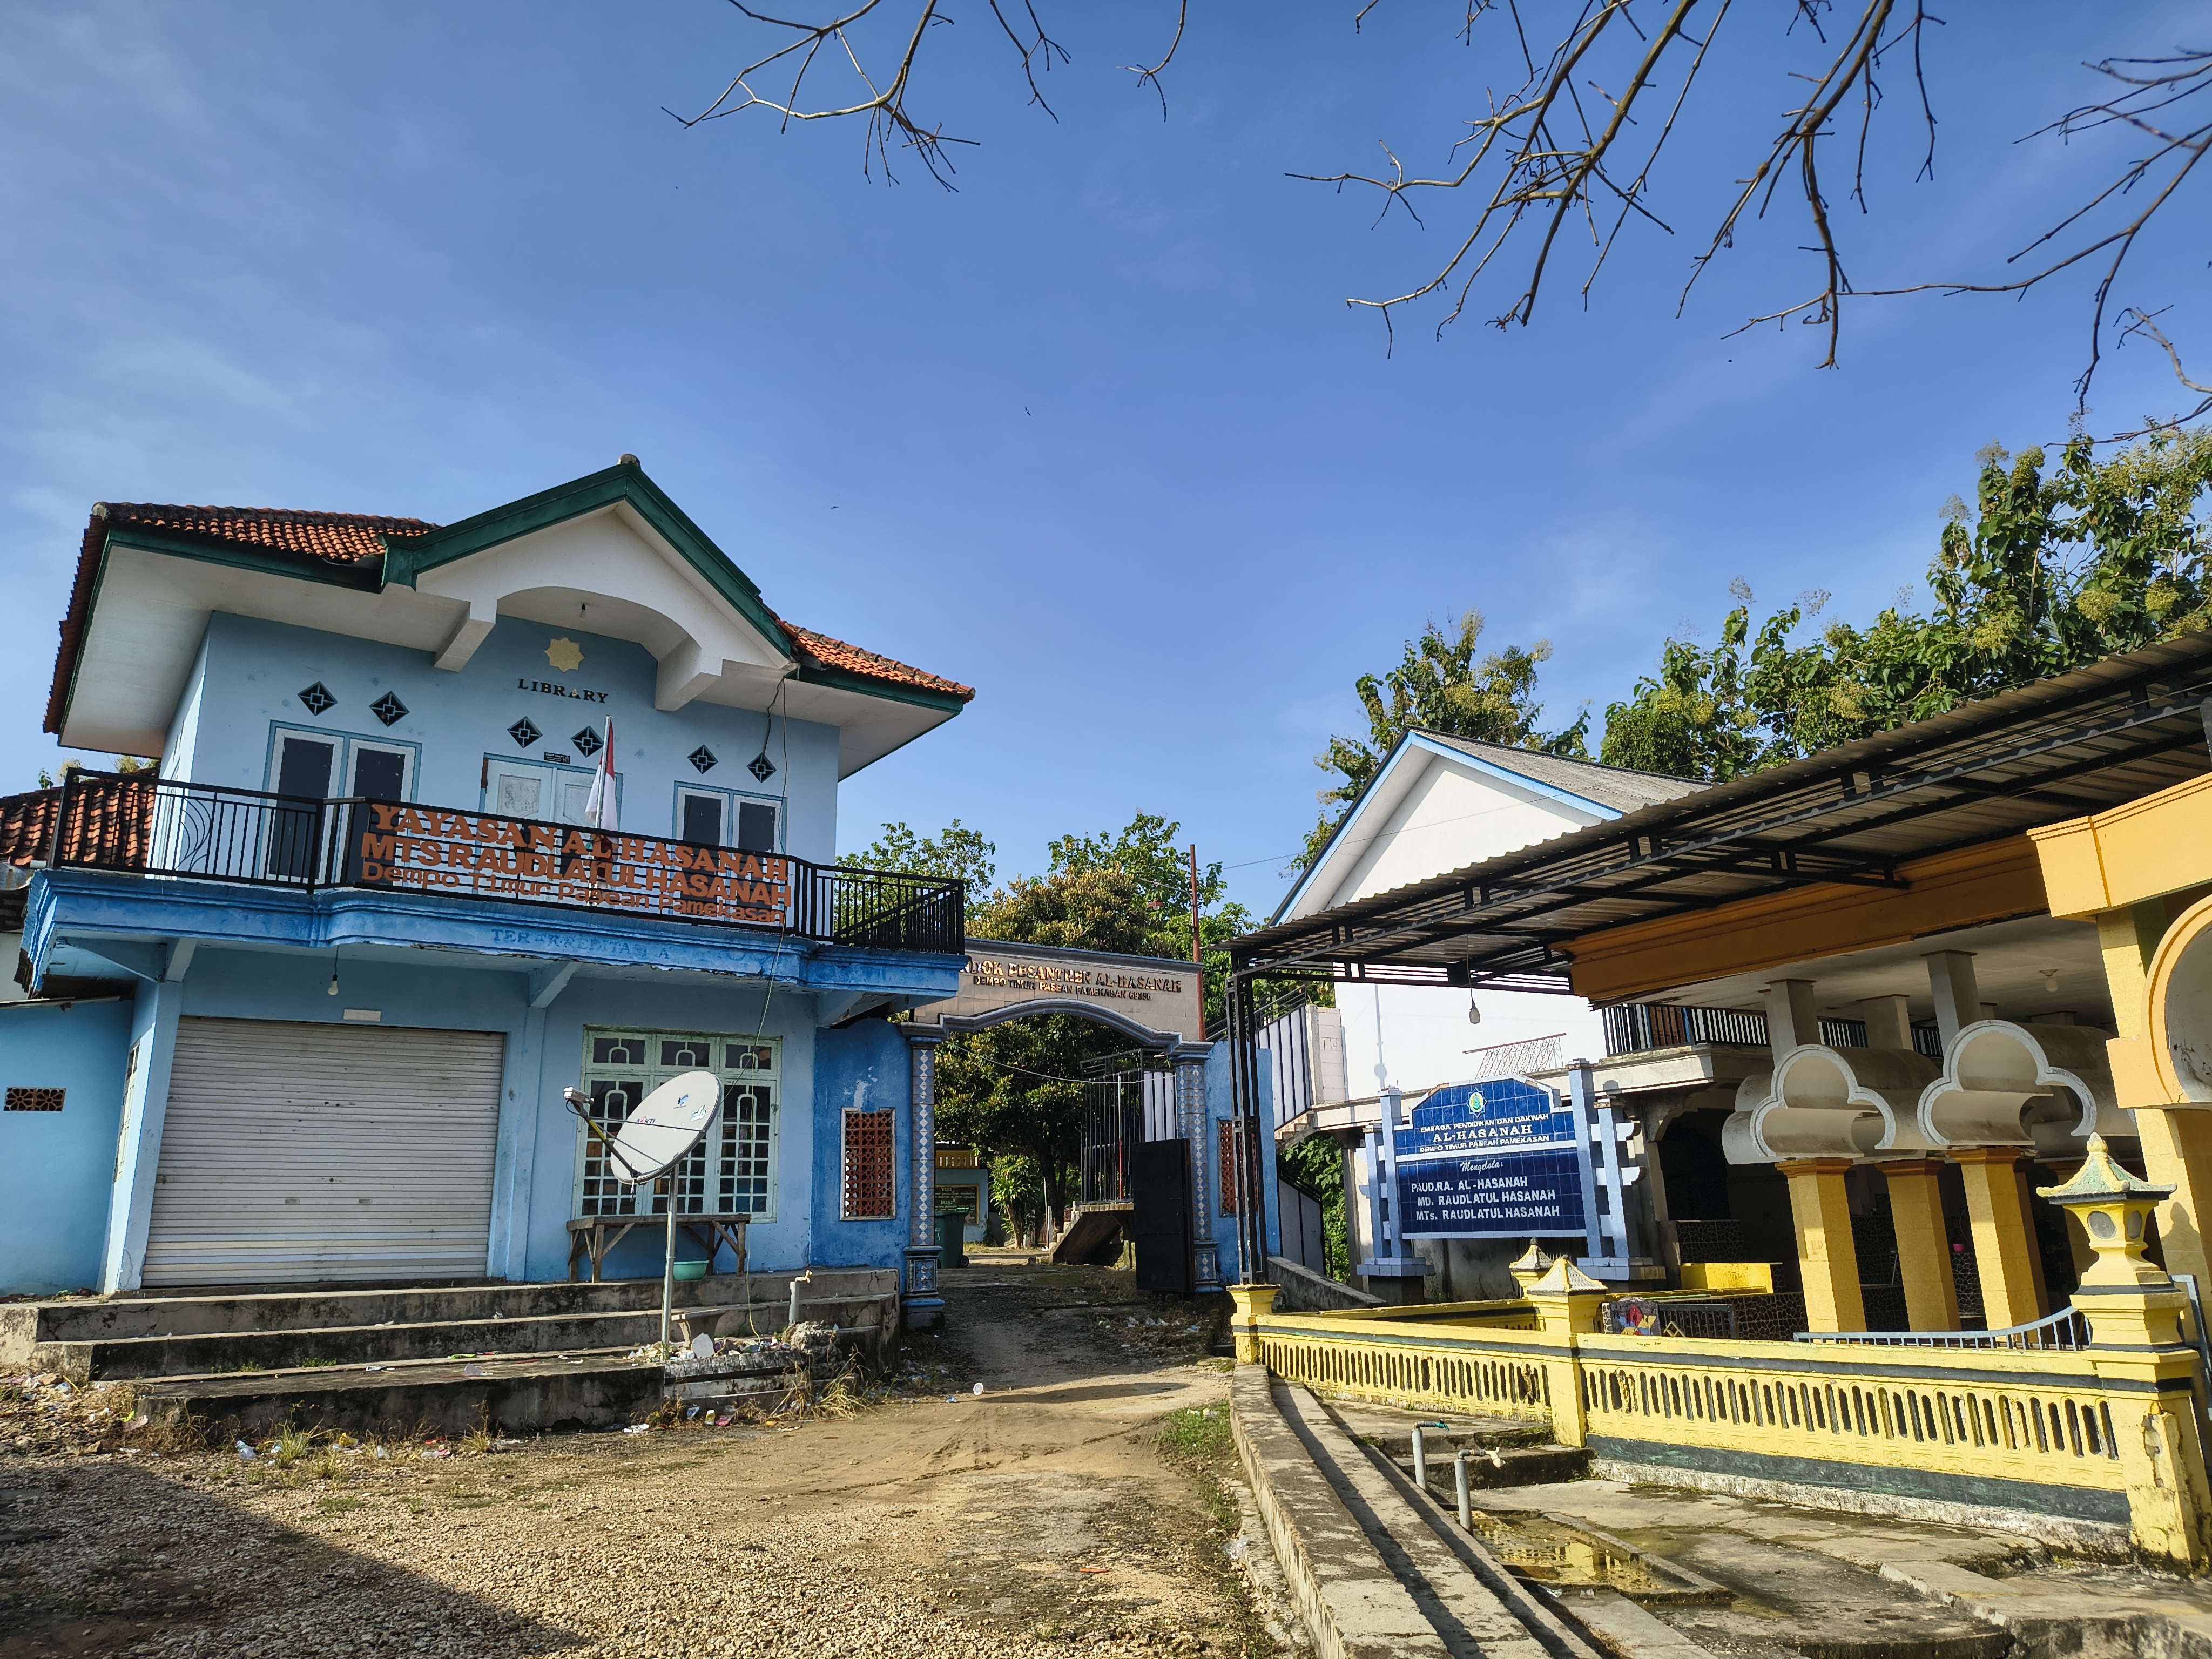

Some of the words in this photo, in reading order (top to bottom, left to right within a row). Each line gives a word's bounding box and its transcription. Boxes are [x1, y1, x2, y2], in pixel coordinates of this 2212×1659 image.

[518, 678, 608, 703] LIBRARY
[361, 832, 442, 866] MTS
[371, 804, 557, 851] YAYASAN
[561, 831, 788, 881] AL-HASANAH
[362, 862, 460, 889] Dempo
[468, 872, 551, 896] Timur
[558, 882, 649, 909] Pasean
[658, 894, 784, 923] Pamekasan
[974, 976, 1007, 987] DEMPO
[1008, 979, 1036, 990] TIMUR
[1039, 981, 1074, 994] PASEAN
[1075, 985, 1127, 999] PAMEKASAN
[1008, 962, 1091, 984] PESANTREN
[1095, 973, 1182, 993] AL-HASANAH
[1453, 1119, 1495, 1129] PENDIDIKAN
[1515, 1113, 1549, 1123] DAKWAH
[1433, 1124, 1533, 1142] AL-HASANAH
[1445, 1142, 1467, 1150] TIMUR
[1500, 1135, 1549, 1145] PAMEKASAN
[1460, 1159, 1503, 1174] Mengelola:
[1417, 1196, 1434, 1206] MD.
[1438, 1192, 1500, 1205] RAUDLATUL
[1502, 1189, 1556, 1202] HASANAH
[1416, 1210, 1438, 1220] MTs.
[1442, 1208, 1504, 1220] RAUDLATUL
[1505, 1205, 1560, 1218] HASANAH
